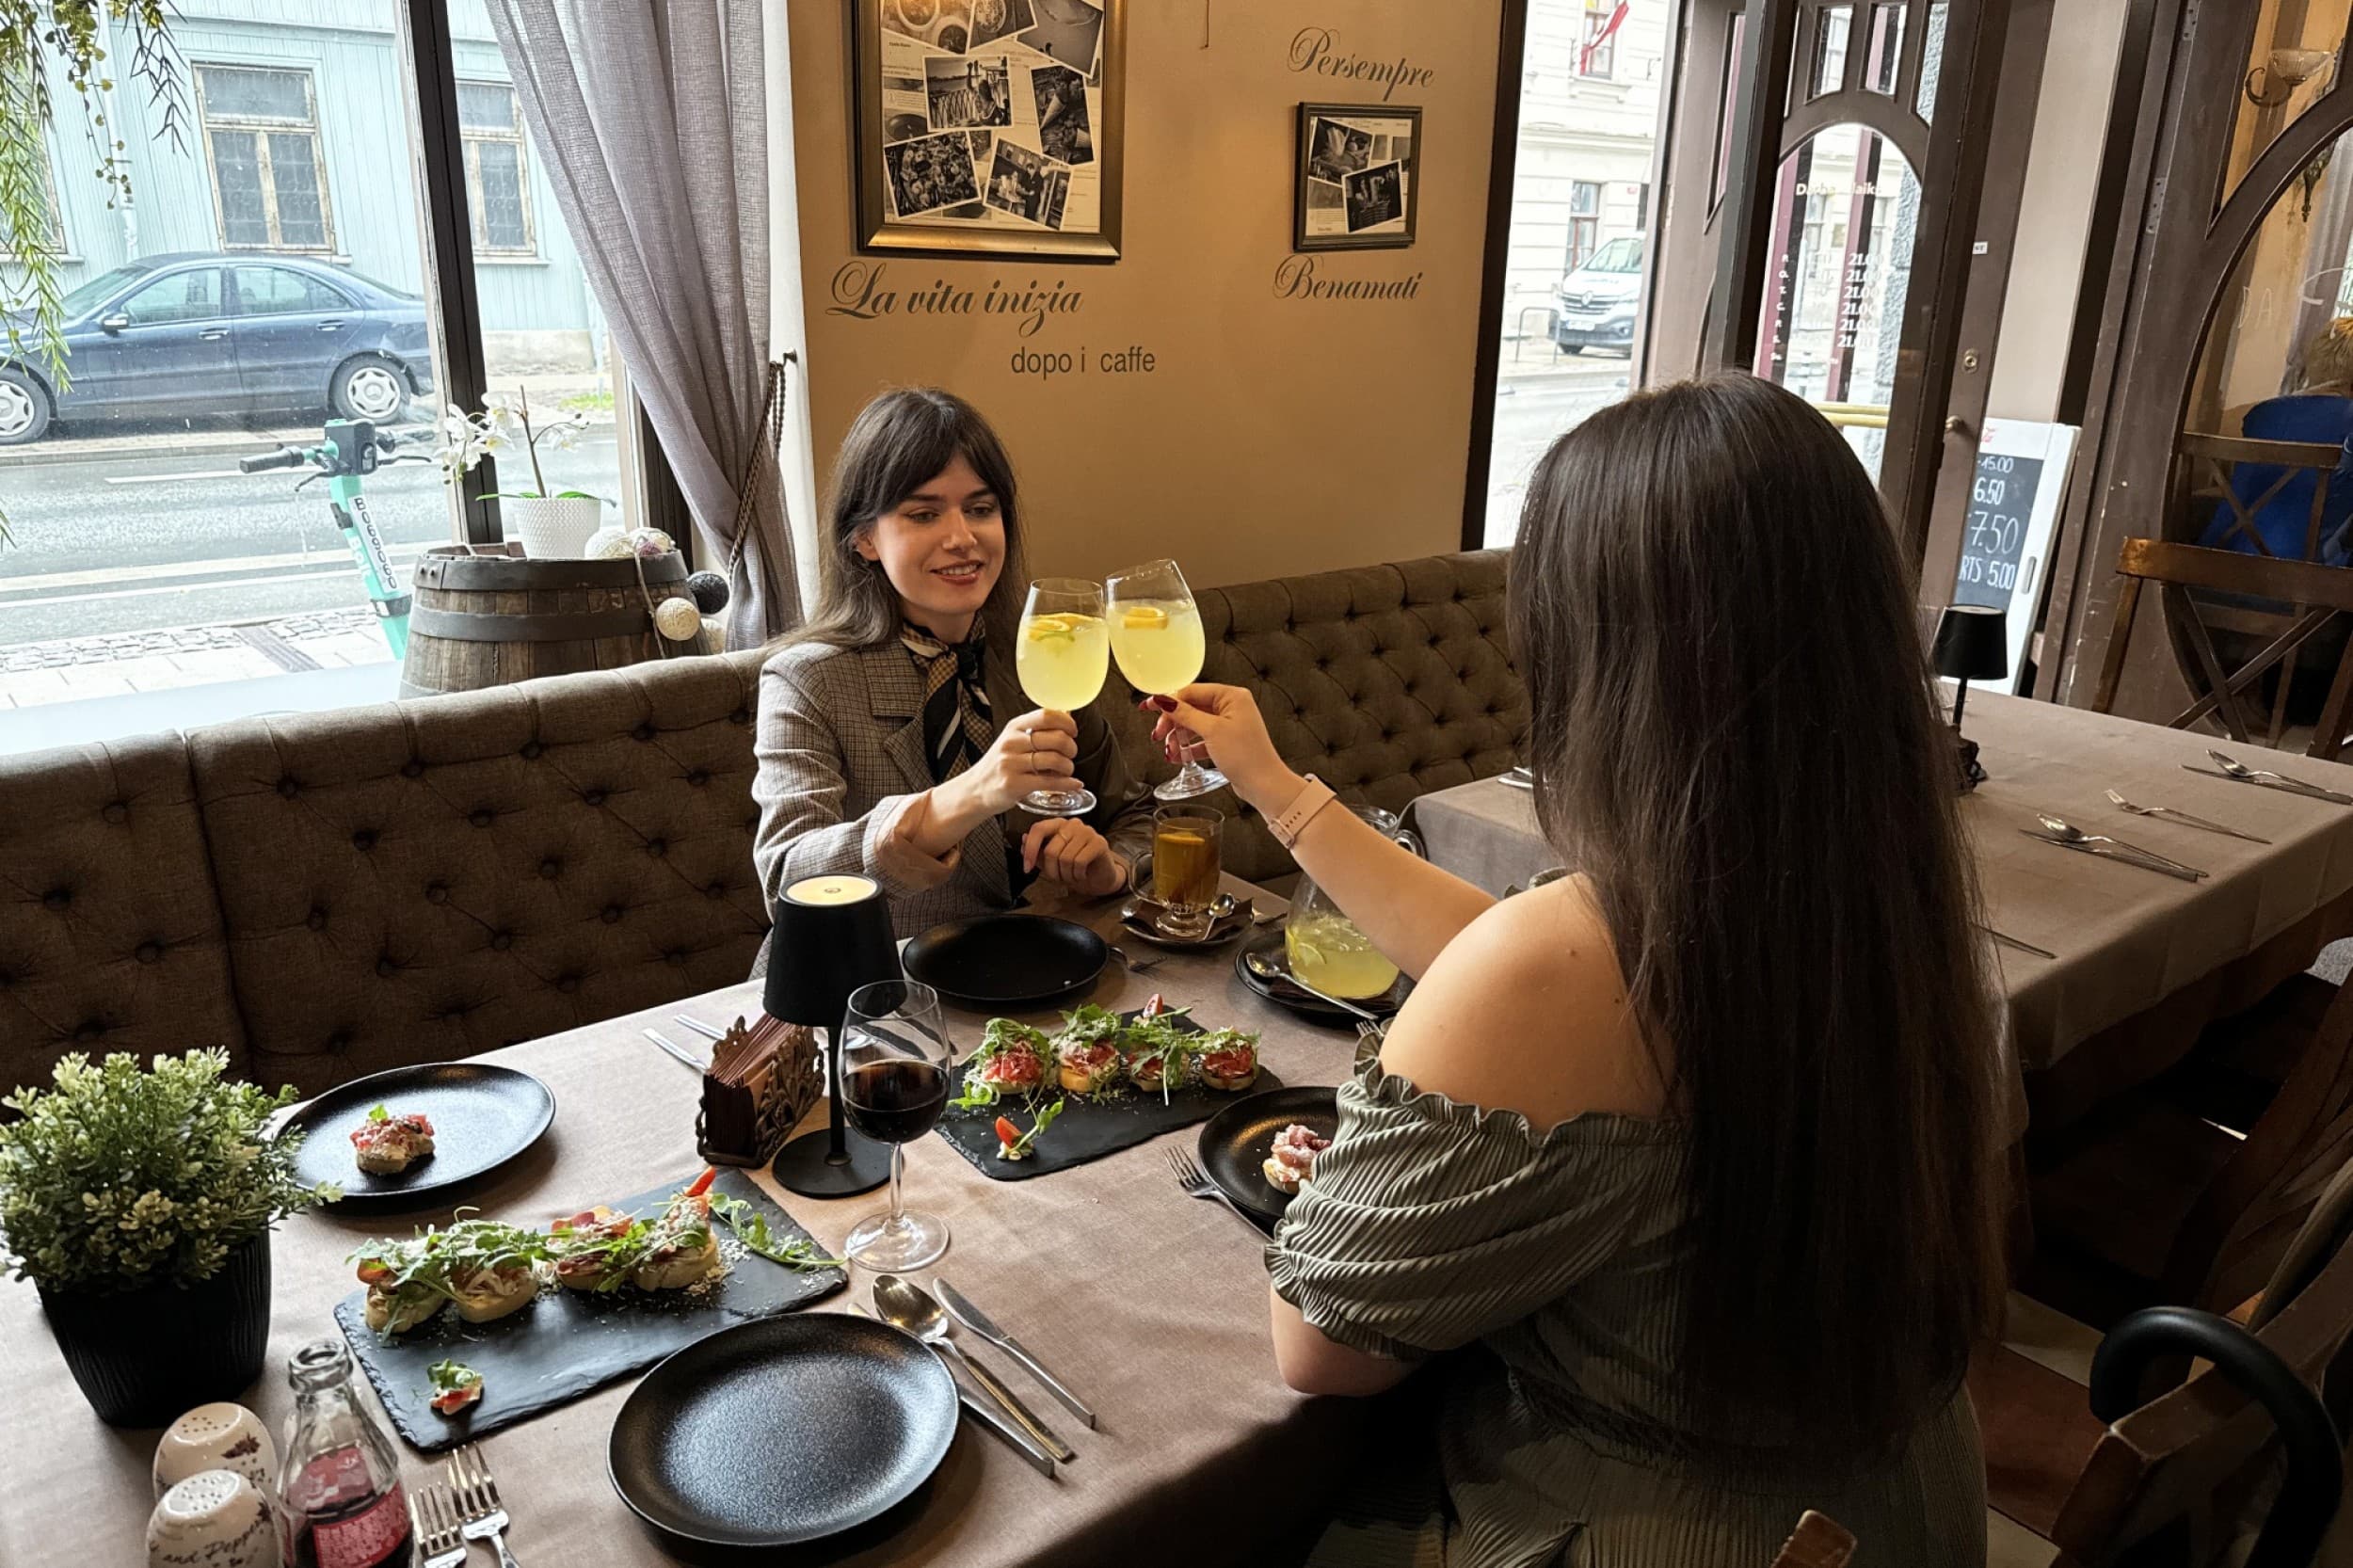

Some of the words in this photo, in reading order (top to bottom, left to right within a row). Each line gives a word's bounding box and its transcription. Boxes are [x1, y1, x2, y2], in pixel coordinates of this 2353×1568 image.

[1288, 26, 1434, 102] Persempre
[824, 261, 899, 320] La
[906, 279, 975, 314] vita
[984, 279, 1083, 339] inizia
[1273, 254, 1423, 300] Benamati
[1011, 346, 1073, 380] dopo
[1080, 346, 1085, 373] i
[1099, 345, 1156, 373] caffe
[1974, 476, 2006, 505] 6.50
[354, 497, 397, 589] B069060
[1959, 554, 1983, 584] RTS
[1986, 560, 2016, 591] 5.00
